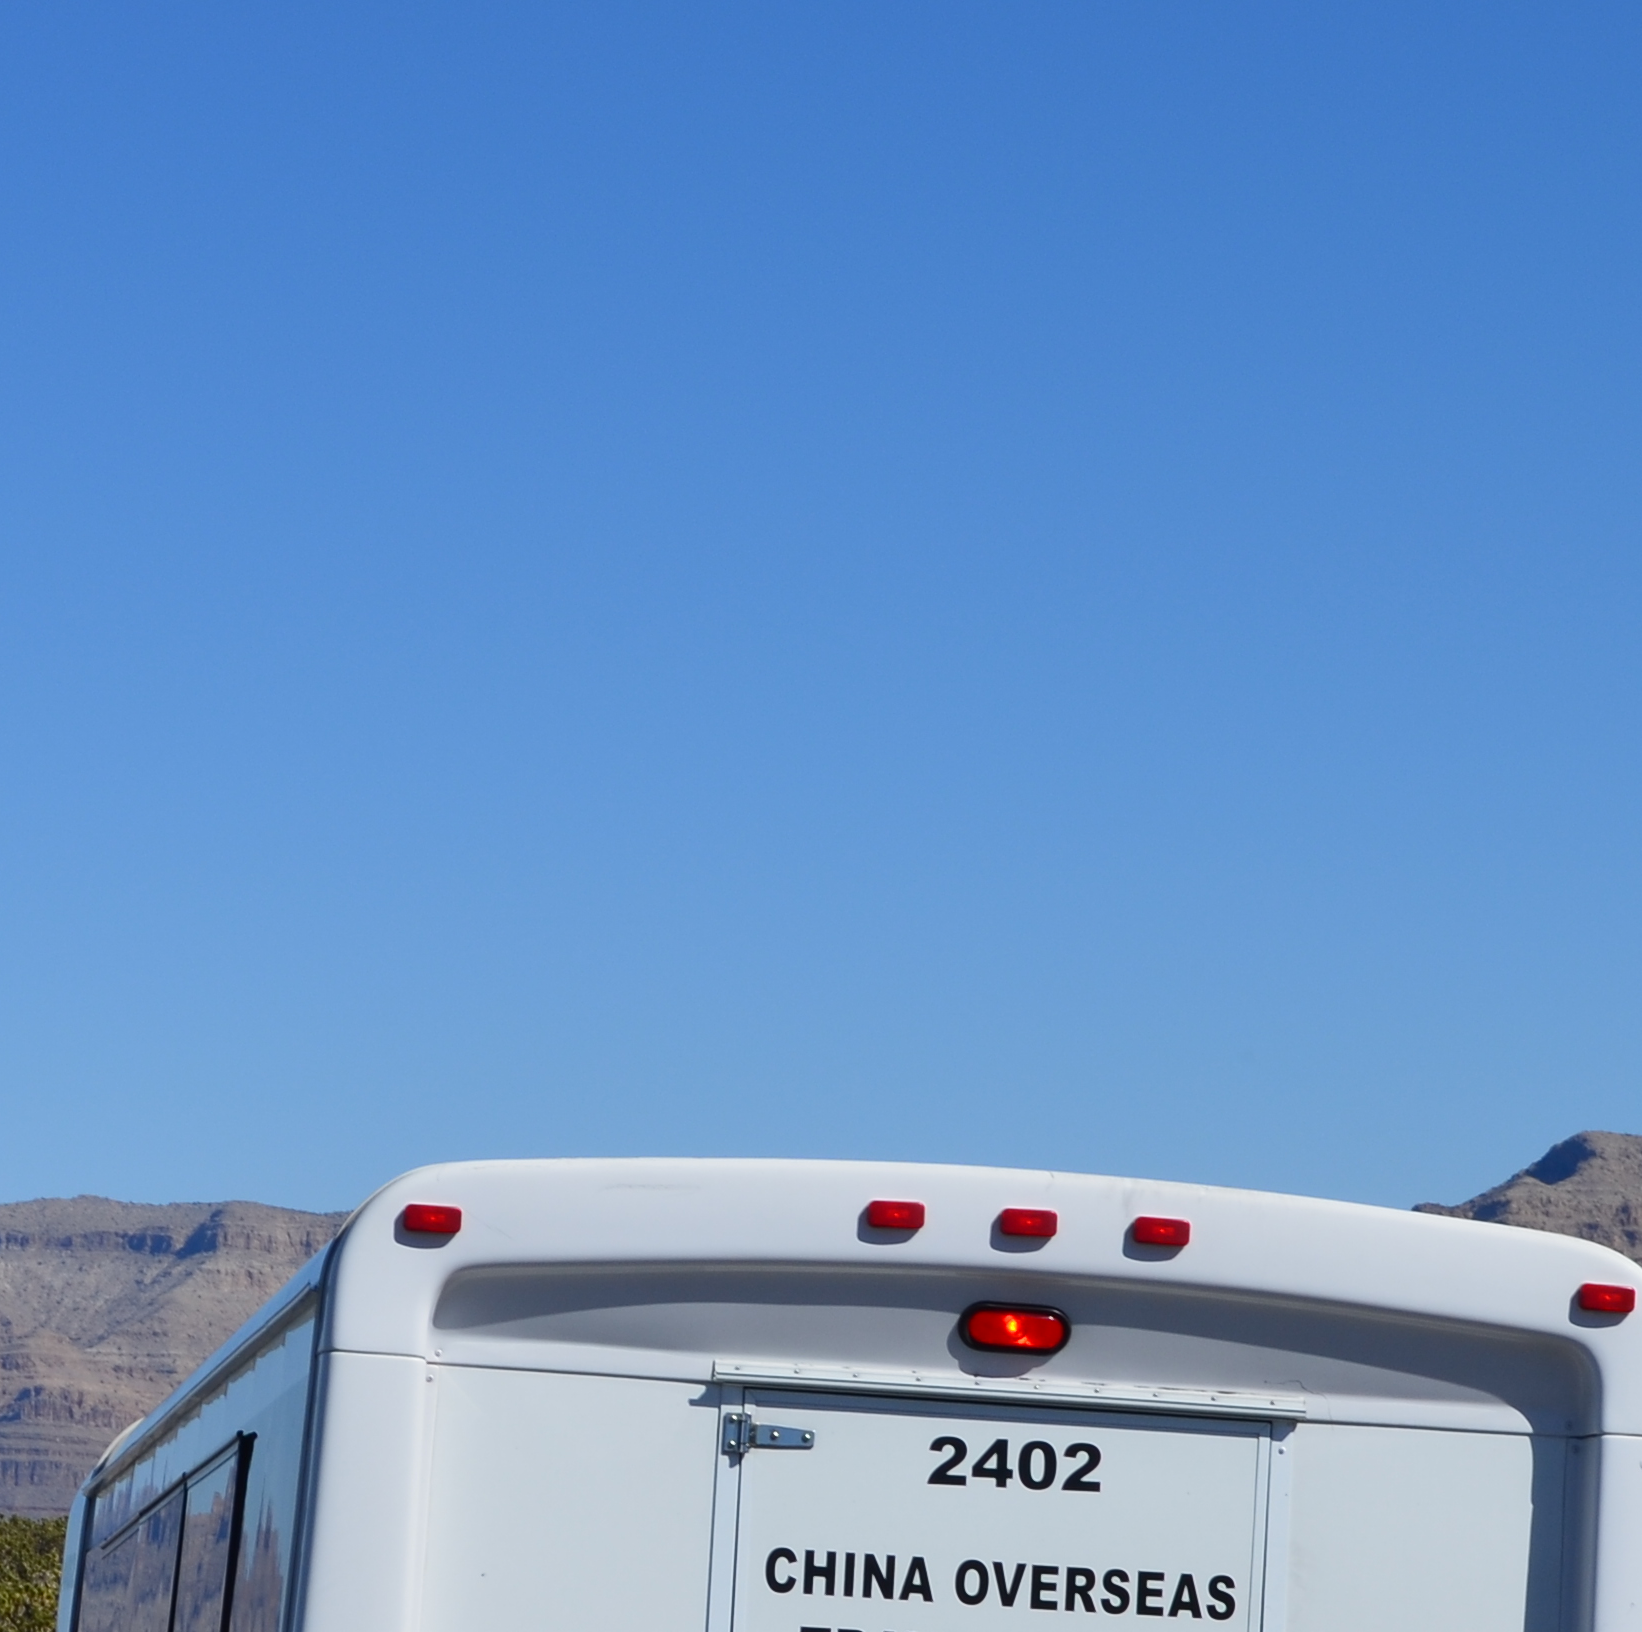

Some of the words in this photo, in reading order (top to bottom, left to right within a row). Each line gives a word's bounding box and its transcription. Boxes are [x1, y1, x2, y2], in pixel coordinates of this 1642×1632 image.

[927, 1435, 1101, 1492] 2402
[765, 1547, 933, 1603] CHINA
[955, 1560, 1236, 1620] OVERSEAS
